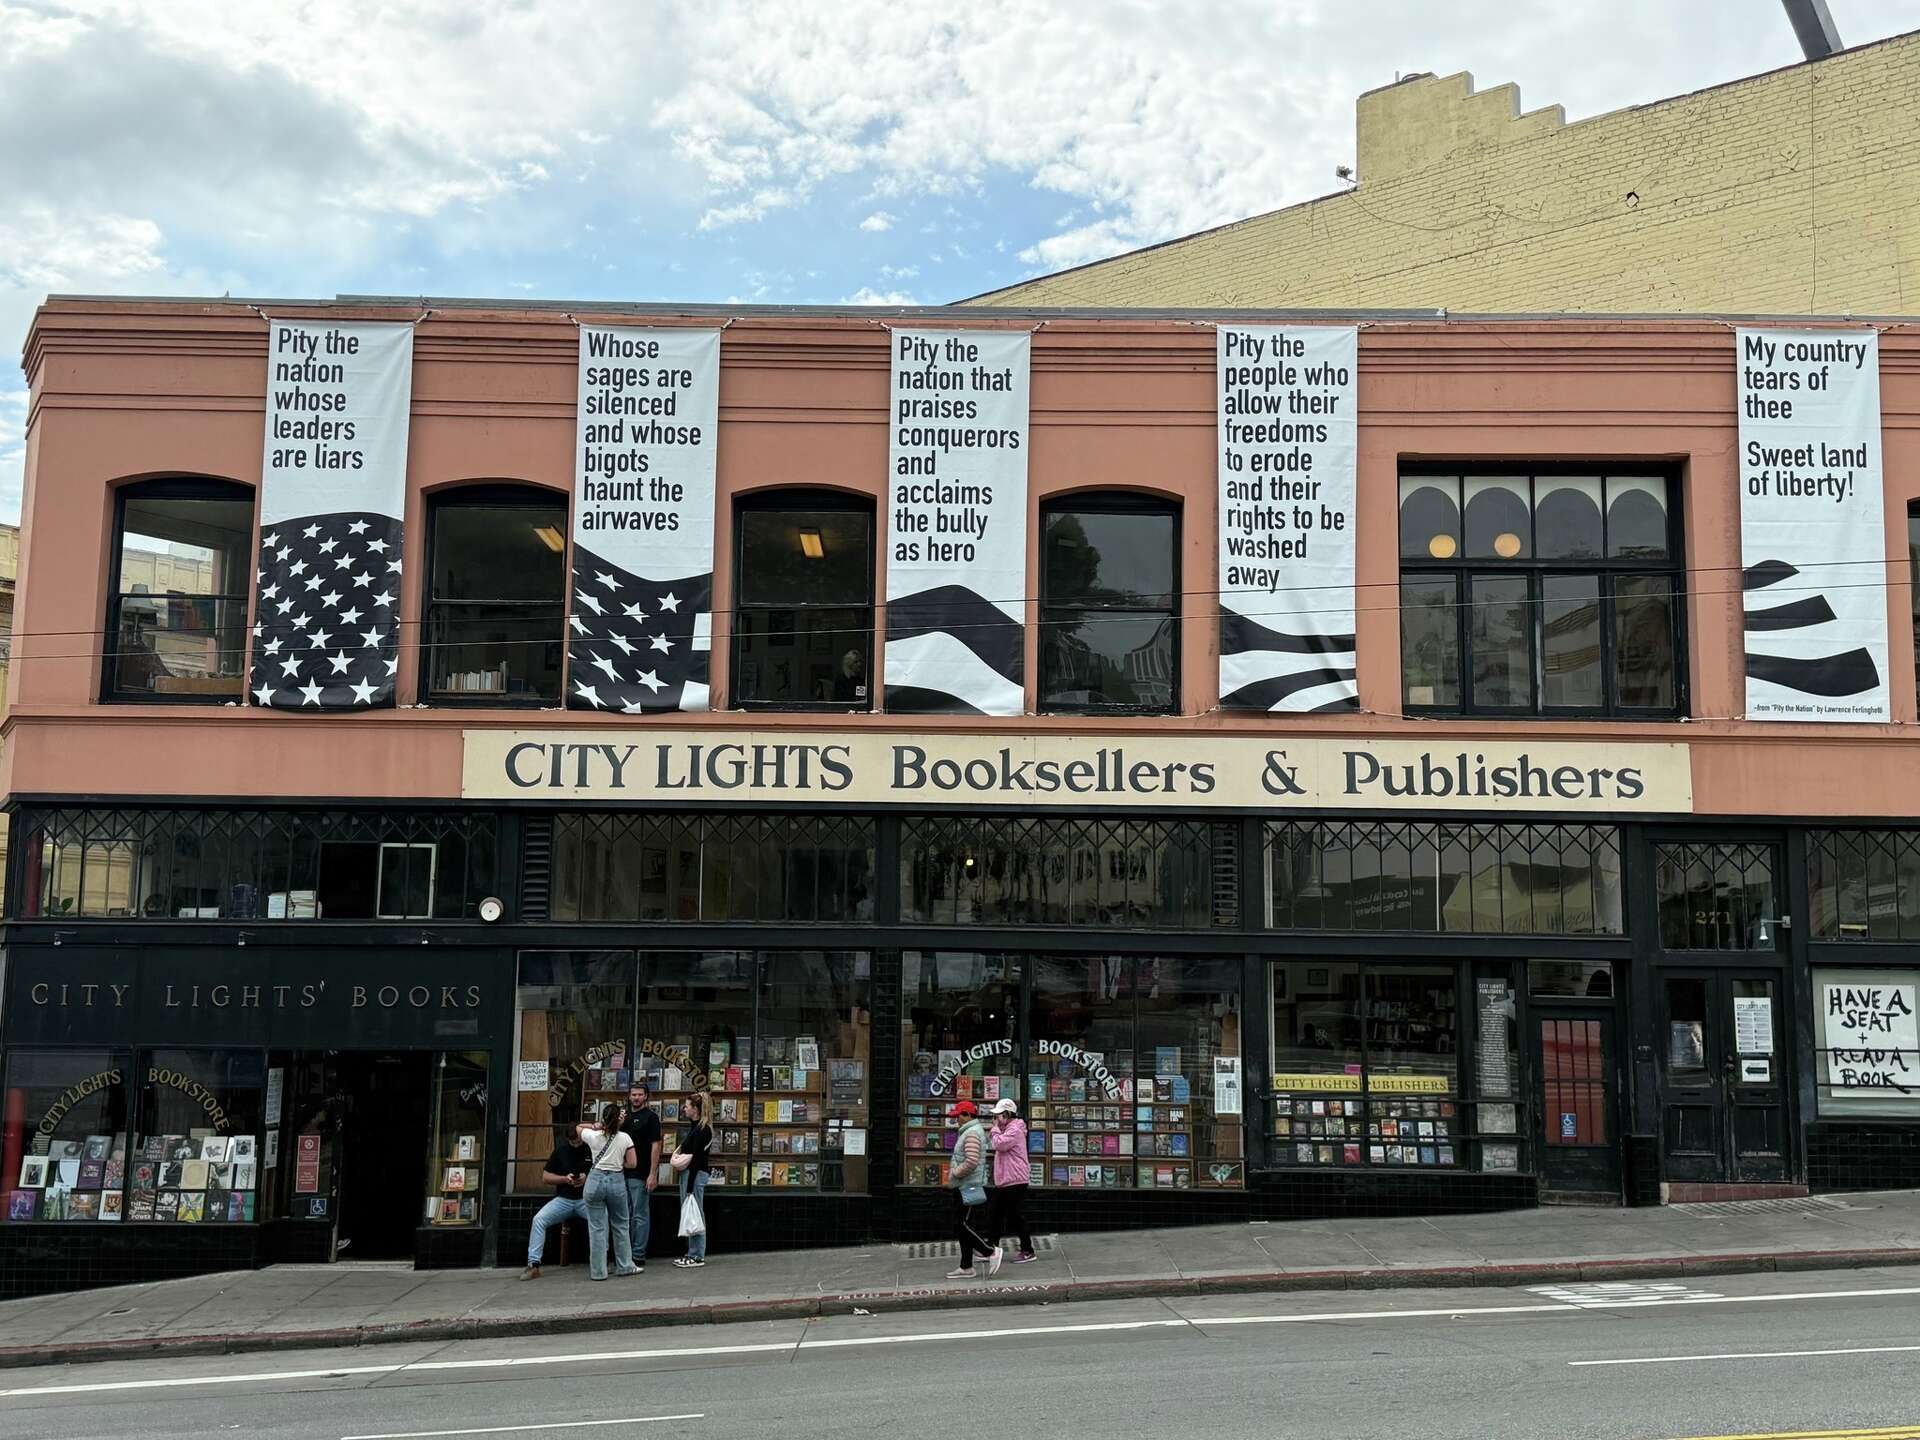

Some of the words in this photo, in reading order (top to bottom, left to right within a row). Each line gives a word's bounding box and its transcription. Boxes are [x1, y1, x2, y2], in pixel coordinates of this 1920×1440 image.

[279, 328, 318, 362] Pity
[325, 330, 358, 354] the
[588, 333, 658, 358] Whose
[901, 337, 939, 371] Pity
[945, 338, 977, 362] the
[1226, 332, 1264, 363] Pity
[1271, 334, 1304, 357] the
[1746, 336, 1776, 367] My
[1785, 340, 1866, 369] country
[277, 355, 343, 382] nation
[587, 368, 649, 393] sages
[658, 370, 691, 388] are
[900, 363, 963, 390] nation
[971, 366, 1012, 391] that
[1226, 361, 1296, 392] people
[1304, 361, 1348, 385] who
[1745, 366, 1800, 390] tears
[1808, 366, 1828, 390] of
[275, 386, 345, 411] whose
[586, 390, 675, 416] silenced
[899, 394, 976, 424] praises
[1225, 389, 1281, 414] allow
[1288, 389, 1339, 413] their
[1745, 393, 1791, 418] thee
[274, 414, 355, 440] leaders
[586, 419, 623, 443] and
[632, 420, 700, 445] whose
[1225, 418, 1327, 443] freedoms
[899, 428, 1019, 453] conquerors
[273, 449, 306, 468] are
[316, 444, 362, 469] liars
[585, 447, 648, 478] bigots
[898, 450, 935, 474] and
[1225, 448, 1242, 471] to
[1251, 446, 1312, 472] erode
[1748, 441, 1814, 467] Sweet
[1822, 443, 1866, 468] land
[584, 476, 643, 501] haunt
[650, 477, 682, 502] the
[897, 479, 992, 504] acclaims
[1227, 476, 1262, 501] and
[1270, 475, 1321, 500] their
[1749, 471, 1769, 495] of
[1777, 471, 1852, 502] liberty!
[582, 507, 679, 531] airwaves
[896, 507, 928, 532] the
[937, 508, 988, 540] bully
[1228, 505, 1285, 535] rights
[1293, 506, 1312, 529] to
[1321, 504, 1344, 530] be
[896, 543, 919, 561] as
[928, 536, 974, 561] hero
[1227, 533, 1306, 559] washed
[1227, 568, 1280, 592] away
[1816, 705, 1824, 714] by
[504, 742, 639, 788] CITY
[655, 743, 853, 790] LIGHTS
[891, 744, 1215, 794] Booksellers
[1261, 750, 1307, 795] &
[1342, 751, 1645, 799] Publishers
[31, 983, 129, 1007] CITY
[352, 985, 481, 1008] BOOKS
[1830, 988, 1881, 1016] HAVE
[1886, 989, 1912, 1015] A
[1841, 1010, 1900, 1032] SEAT
[930, 1060, 960, 1096] CITY
[957, 1039, 1012, 1069] LIGHTS
[1038, 1039, 1123, 1101] BOOKSTORE
[1833, 1047, 1885, 1068] READ
[1890, 1046, 1909, 1072] A
[549, 1070, 574, 1107] CITY
[571, 1039, 626, 1074] LIGHTS
[1276, 1078, 1306, 1088] CITY
[1310, 1079, 1358, 1089] LIGHTS
[1368, 1080, 1446, 1091] UBLISHERS
[1840, 1068, 1911, 1094] BOOK
[40, 1092, 70, 1134] CITY
[67, 1069, 121, 1103] LIGHTS
[148, 1068, 231, 1133] BOOKSTORE
